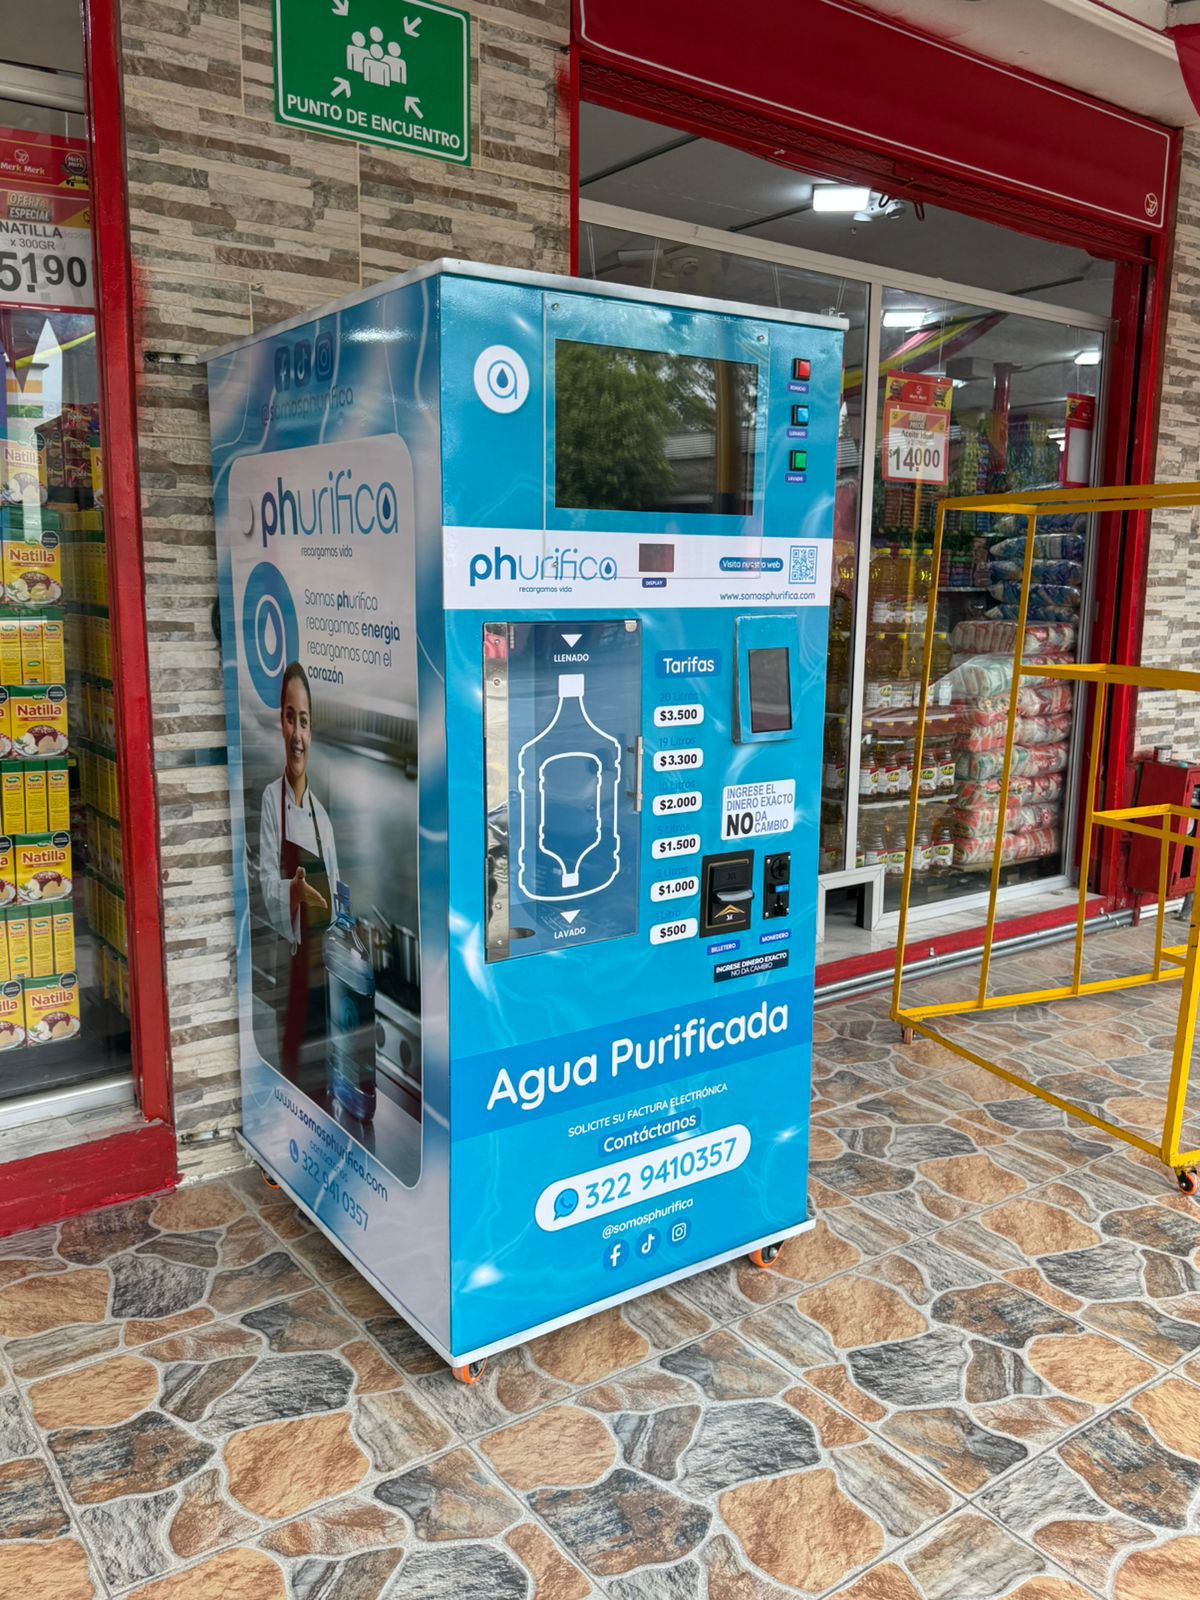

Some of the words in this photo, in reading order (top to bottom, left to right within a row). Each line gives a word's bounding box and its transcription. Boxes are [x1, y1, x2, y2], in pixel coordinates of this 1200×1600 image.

[287, 93, 343, 121] PUNTO
[346, 108, 368, 127] DE
[371, 114, 460, 149] ENCUENTRO
[0, 161, 22, 172] Merk
[24, 165, 45, 176] Merk
[9, 193, 49, 208] OFERTA
[9, 207, 50, 222] ESPECIAL
[0, 220, 63, 239] NATILLA
[18, 238, 56, 251] 300GR
[261, 384, 354, 426] @somosphurifica
[5, 448, 43, 465] Natilla
[261, 468, 399, 548] phurifica
[9, 549, 55, 562] Natilla
[301, 545, 338, 560] recargamos
[339, 545, 353, 558] vida
[469, 546, 618, 587] phurifica
[722, 560, 741, 568] Visita
[519, 586, 558, 594] recargamos
[720, 590, 816, 602] www.somosphurifica.com
[304, 588, 335, 608] Somos
[336, 590, 378, 611] phurifica
[306, 616, 359, 637] recargamos
[307, 641, 360, 662] recargamos
[362, 649, 381, 665] con
[383, 649, 392, 667] el
[553, 653, 590, 663] LLENADO
[662, 656, 715, 674] Tarifas
[307, 665, 344, 685] corazón
[17, 704, 62, 716] Natilla
[659, 709, 698, 722] $3.500
[659, 737, 669, 747] 19
[670, 736, 696, 746] Litros
[659, 753, 698, 767] $3.300
[727, 784, 765, 799] INGRESE
[766, 784, 776, 795] EL
[659, 796, 697, 811] $2.000
[726, 797, 759, 812] DINERO
[760, 794, 793, 807] EXACTO
[755, 811, 768, 822] DA
[665, 824, 690, 834] Litros
[726, 812, 754, 837] NO
[754, 819, 789, 834] CAMBIO
[659, 838, 696, 853] $1.500
[22, 850, 66, 863] Natilla
[664, 866, 689, 877] Litros
[658, 880, 695, 896] $1.000
[554, 927, 586, 939] LAVADO
[659, 924, 687, 939] $500
[761, 931, 789, 943] MONEDERO
[711, 942, 737, 953] BILLETERO
[715, 961, 741, 974] INGRESE
[741, 956, 764, 968] DINERO
[764, 952, 788, 963] EXACTO
[730, 969, 740, 977] NO
[740, 967, 750, 975] DA
[750, 962, 773, 974] CAMBIO
[31, 991, 74, 1006] Natilla
[486, 1053, 598, 1111] Agua
[611, 1000, 789, 1077] Purificada
[568, 1117, 612, 1138] SOLICITE
[612, 1112, 626, 1125] SU
[627, 1101, 669, 1120] FACTURA
[669, 1082, 728, 1109] ELECTRÓNICA
[603, 1113, 697, 1153] Contáctanos
[274, 1087, 388, 1202] www.somosphurifica.com
[584, 1172, 632, 1209] 322
[640, 1137, 738, 1191] 9410357
[302, 1150, 320, 1185] 322
[322, 1173, 340, 1203] 941
[342, 1191, 369, 1232] 0357
[602, 1198, 694, 1239] @somosphurifica
